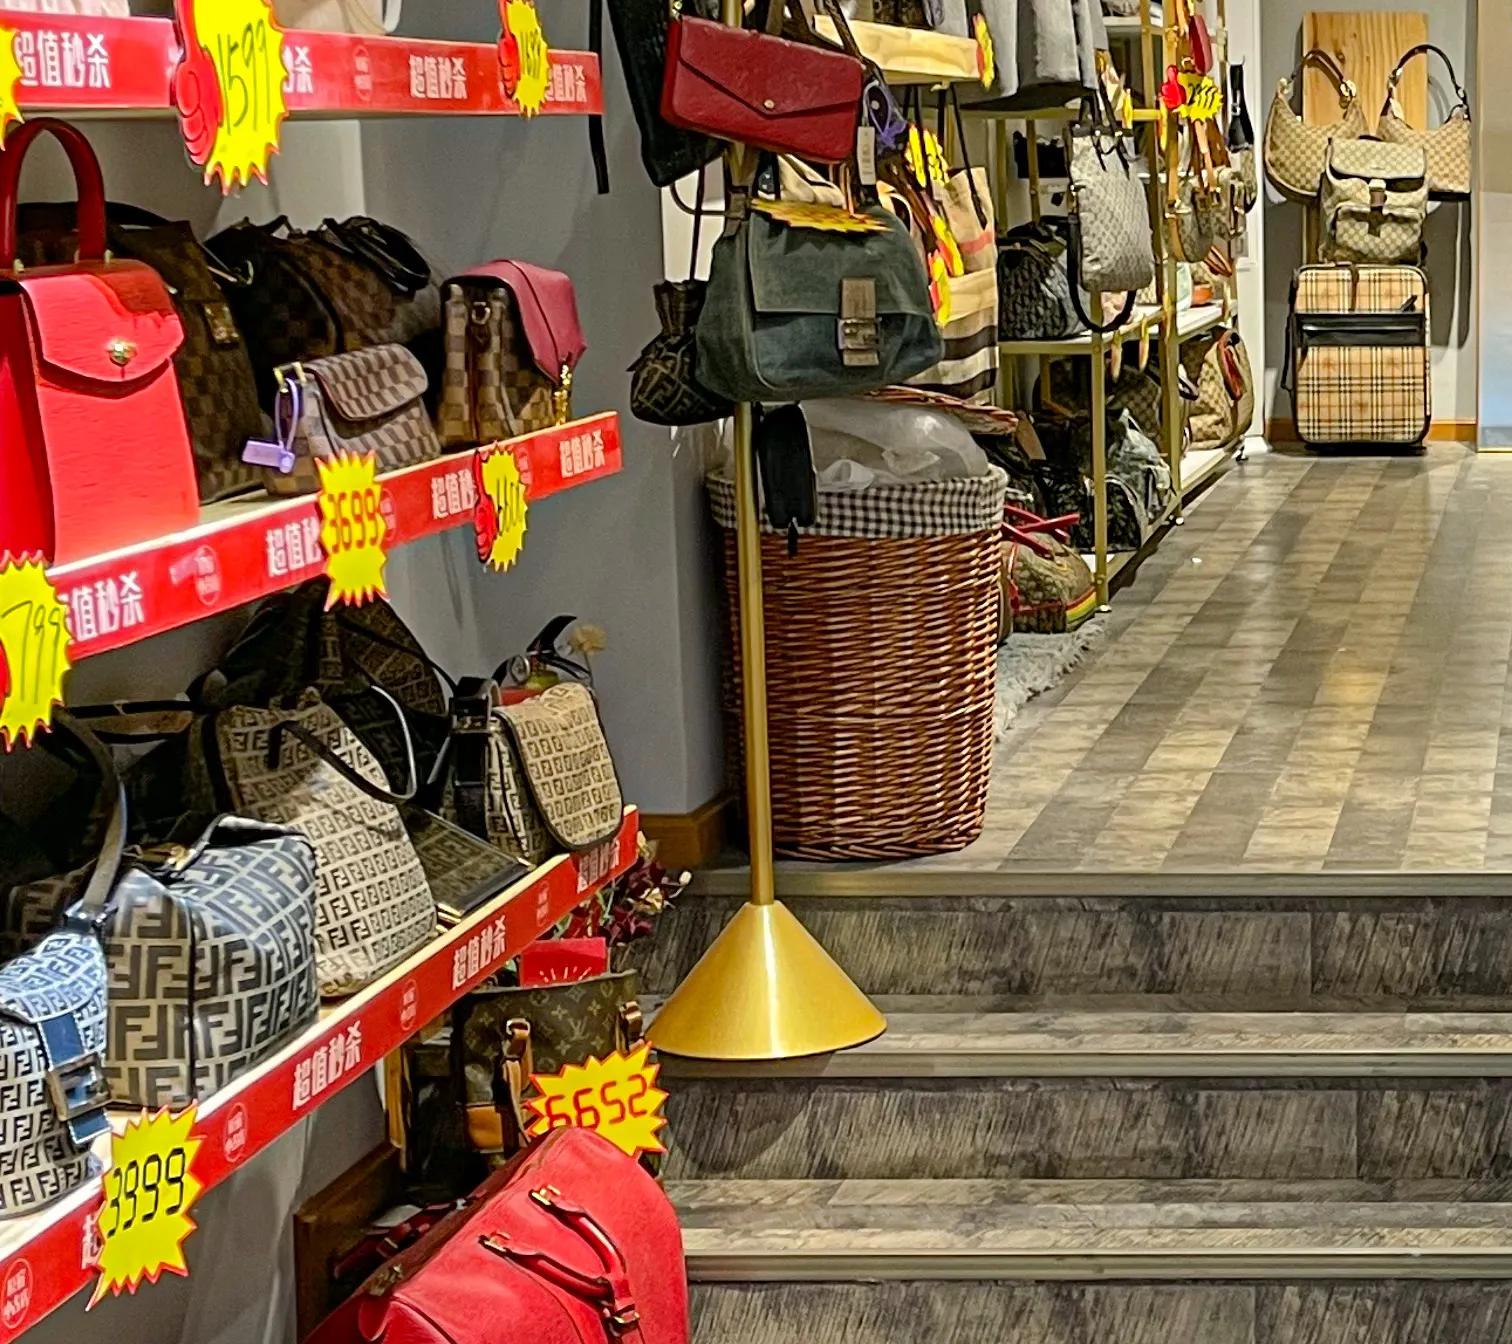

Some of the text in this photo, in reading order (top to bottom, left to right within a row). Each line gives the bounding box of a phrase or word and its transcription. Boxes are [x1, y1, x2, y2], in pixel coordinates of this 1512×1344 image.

[217, 18, 271, 135] 1599
[409, 54, 467, 99] 超值秒杀
[559, 428, 606, 479] 超值秒杀
[327, 487, 379, 554] 3699
[58, 571, 145, 644] 值秒杀
[452, 915, 507, 991] 超值秒杀
[292, 1019, 362, 1111] 超值秒杀
[545, 1073, 648, 1131] 6652
[106, 1147, 186, 1238] 3999
